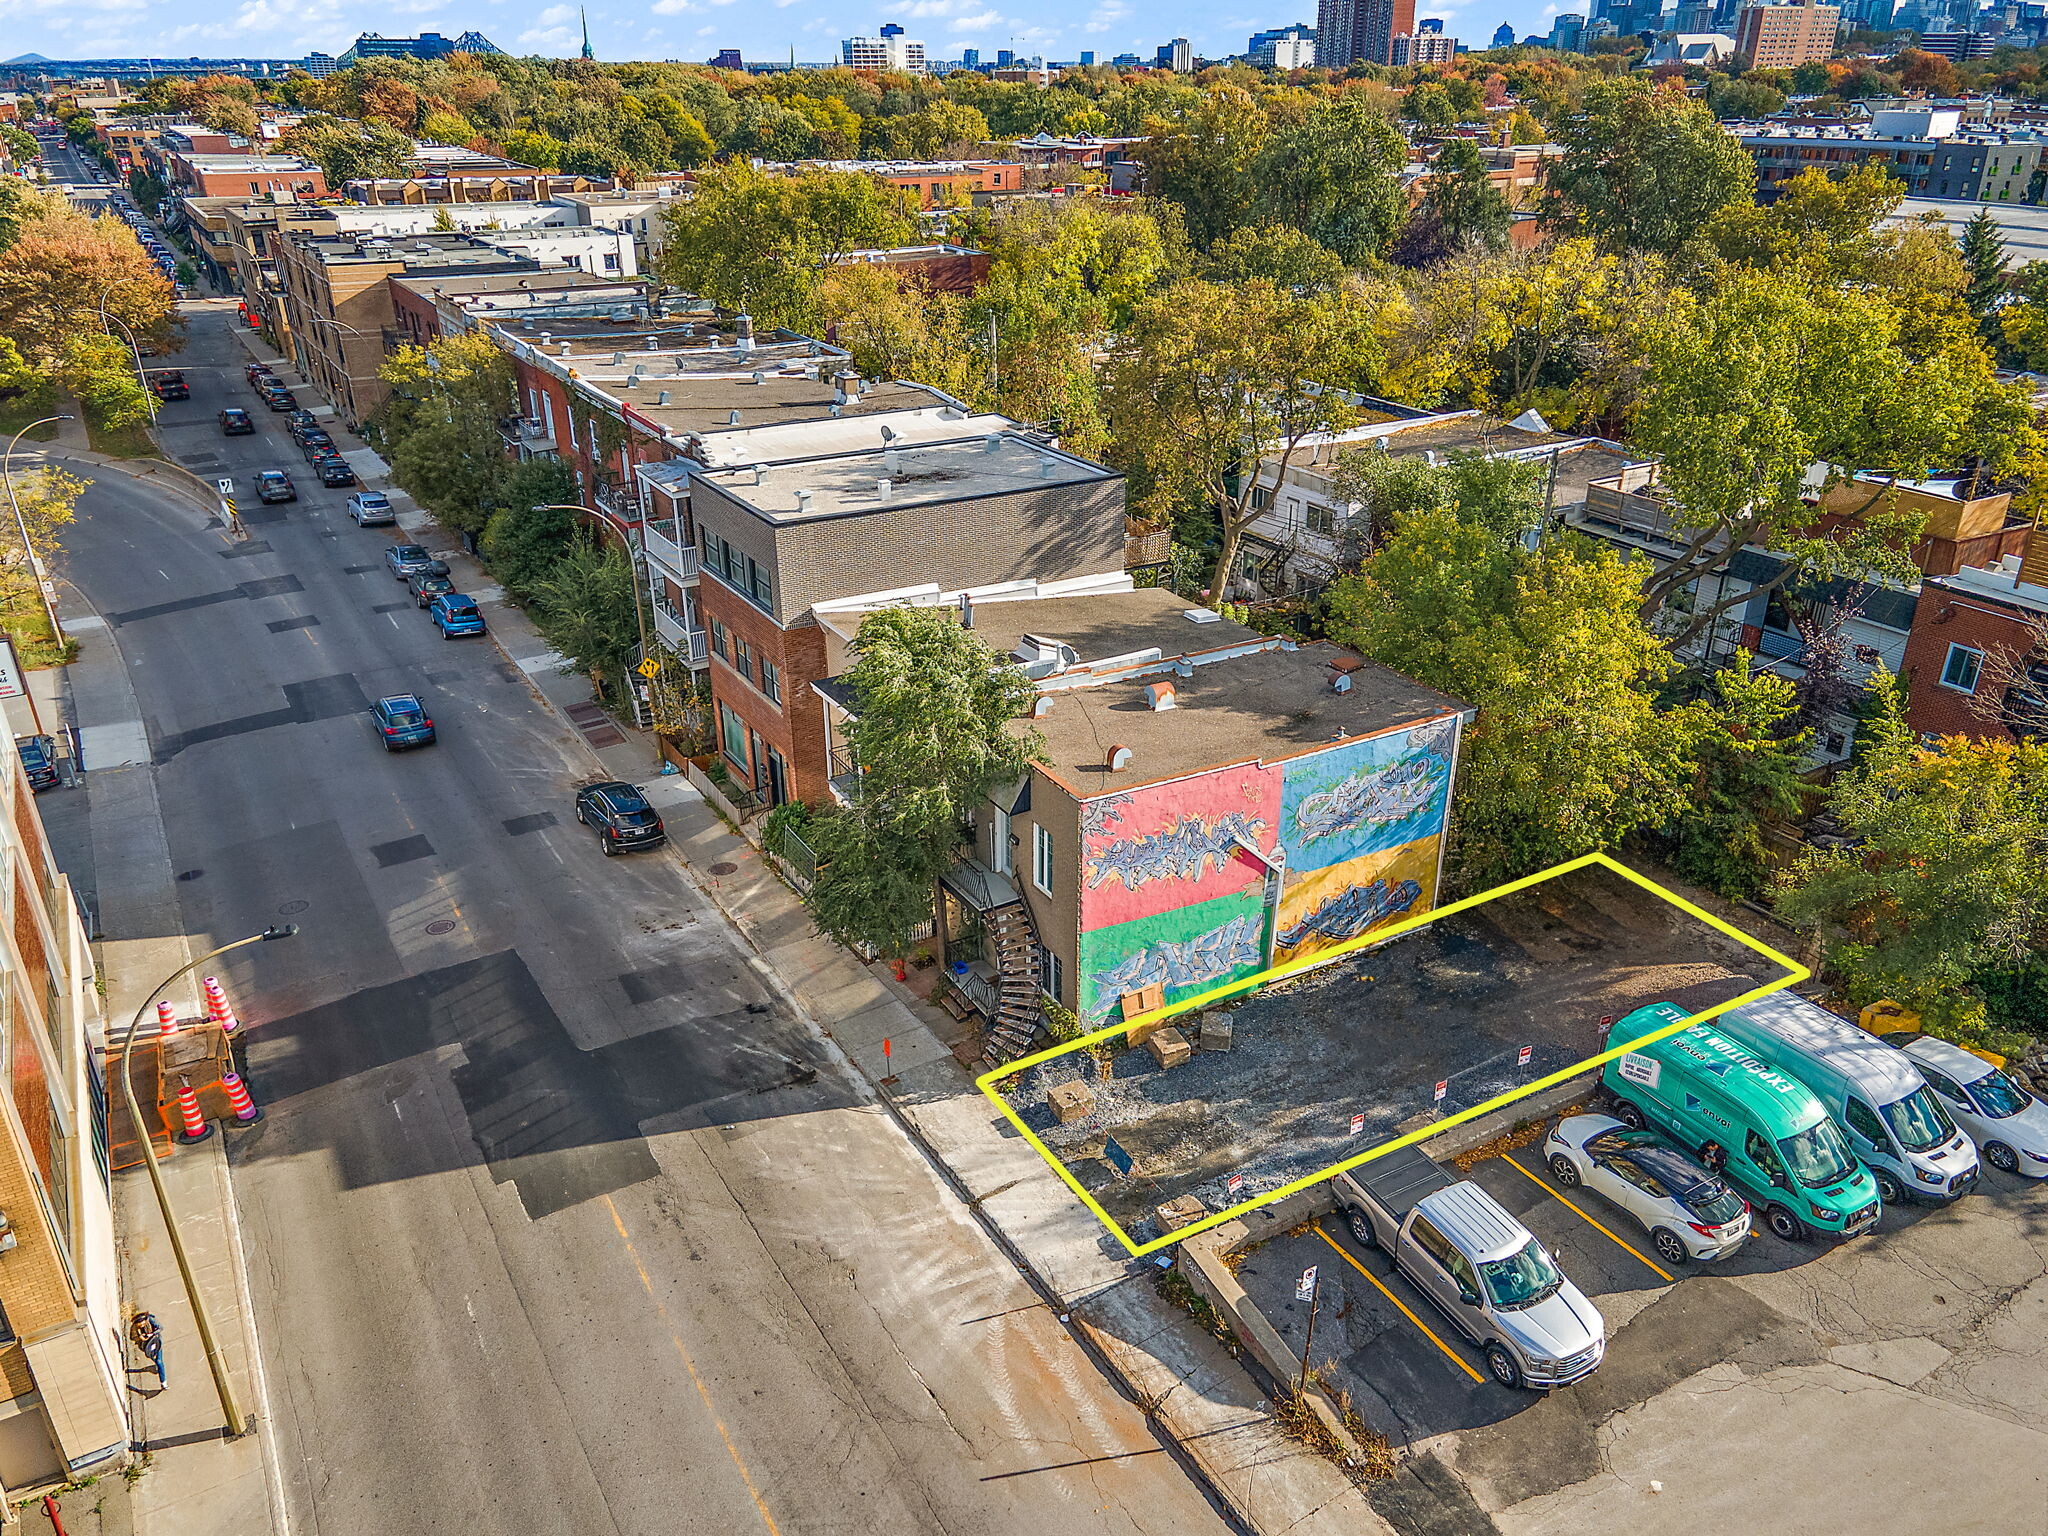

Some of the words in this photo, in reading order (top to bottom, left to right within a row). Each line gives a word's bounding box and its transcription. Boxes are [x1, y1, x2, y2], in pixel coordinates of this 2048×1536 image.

[1655, 1007, 1711, 1039] FAILE
[1670, 1039, 1706, 1061] envoi
[1702, 1107, 1731, 1129] envoi
